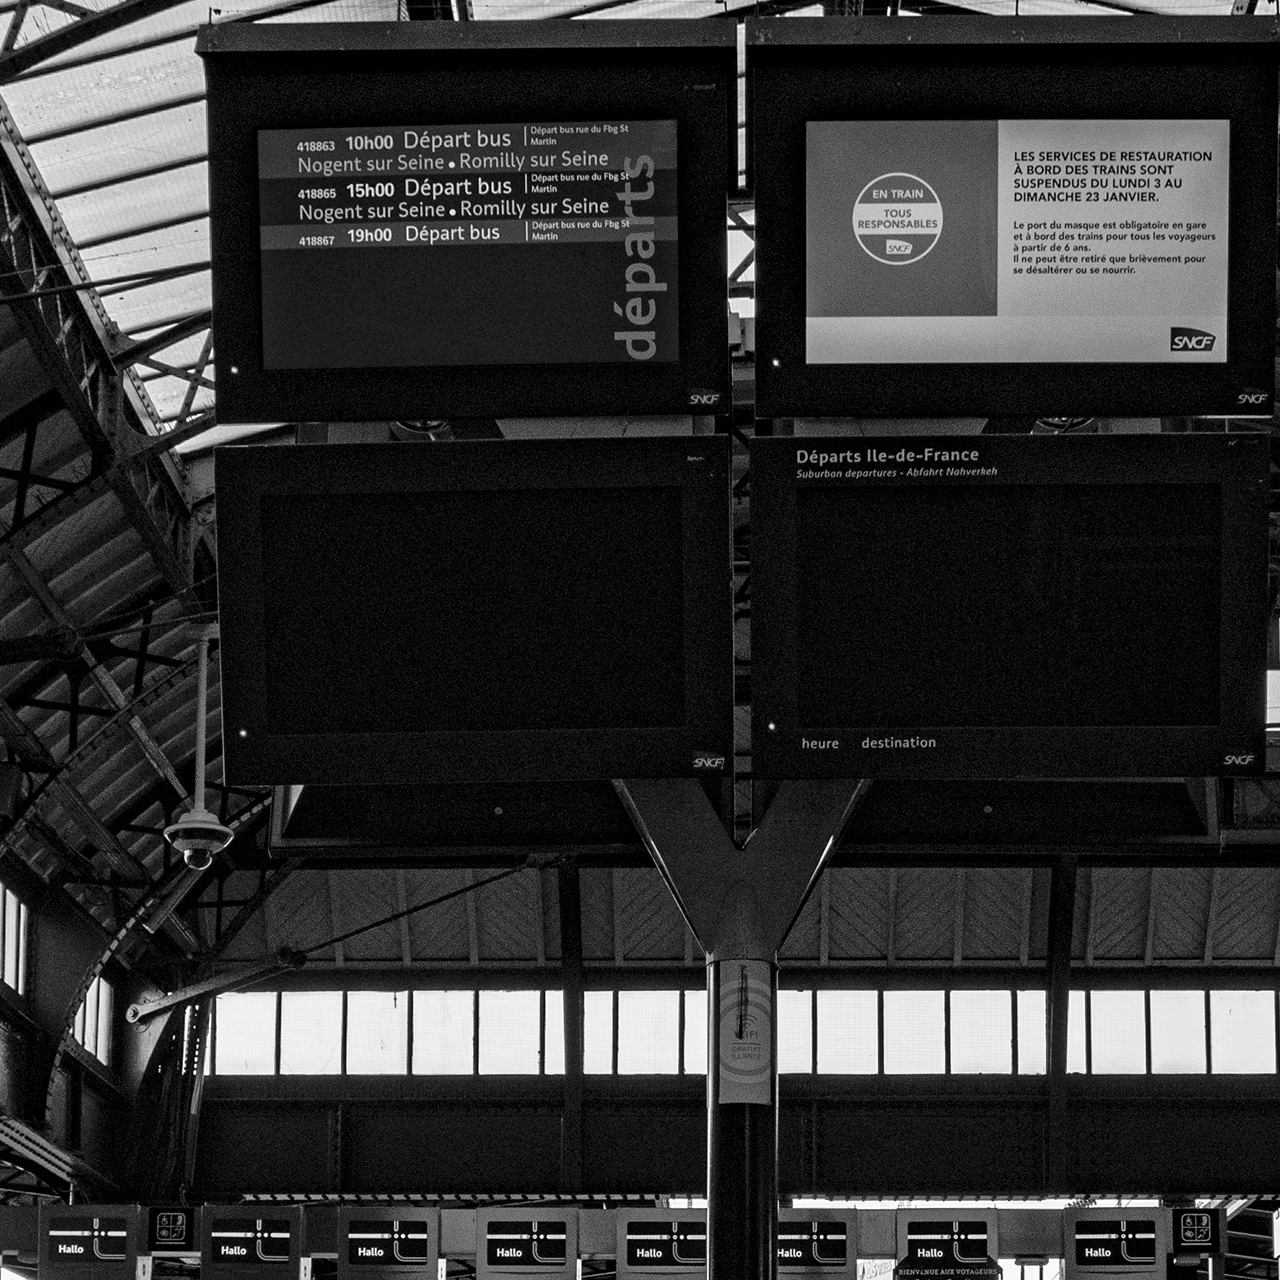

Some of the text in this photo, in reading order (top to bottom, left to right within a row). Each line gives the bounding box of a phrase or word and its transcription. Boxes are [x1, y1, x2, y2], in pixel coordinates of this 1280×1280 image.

[530, 126, 558, 136] Départ
[559, 126, 574, 134] bus
[590, 125, 601, 133] du
[603, 124, 618, 134] Fbg
[620, 124, 629, 133] St
[297, 129, 511, 153] 418863 10h00 Départ bus
[530, 137, 557, 146] Martin
[1014, 151, 1212, 162] LES SERVICES DE RESTAURATION
[298, 151, 608, 177] Nogent sur Seine Romilly sur Seine
[1014, 163, 1174, 175] À BORD DES TRAINS SONT
[531, 173, 558, 184] Départ
[560, 173, 575, 182] bus
[591, 172, 602, 181] du
[604, 172, 619, 182] Fbg
[620, 172, 630, 181] St
[1014, 178, 1182, 189] SUSPENDUS DU LUNDI 3 AU
[298, 177, 512, 200] 418865 15h00 Départ bus
[531, 184, 558, 193] Martin
[872, 189, 923, 199] EN TRAIN
[1014, 191, 1159, 202] DIMANCHE 23 JANVIER.
[300, 197, 609, 224] Nogent sur Seine Romilly sur Seine
[884, 208, 912, 218] TOUS
[532, 221, 559, 231] Départ
[561, 221, 576, 229] bus
[592, 220, 602, 228] du
[604, 219, 620, 229] Fbg
[621, 219, 630, 228] St
[858, 219, 938, 229] RESPONSABLES
[1014, 220, 1207, 232] Le port du masque est obligatoire en gare
[299, 224, 500, 246] 418867 19h00 Départ bus
[532, 232, 558, 240] Martin
[1013, 230, 1216, 243] et à bord des trains pour tous les voyageurs
[887, 244, 911, 253] SNCF
[1013, 243, 1019, 252] à
[1022, 243, 1047, 254] partir
[1050, 242, 1062, 252] de
[1064, 243, 1070, 252] 6
[614, 153, 668, 361] départs
[1013, 254, 1019, 263] Il
[1036, 255, 1056, 265] peut
[1059, 254, 1078, 263] être
[1081, 254, 1106, 263] retiré
[1109, 256, 1126, 265] que
[1129, 253, 1182, 263] brièvement
[1184, 256, 1206, 265] pour
[1026, 265, 1073, 274] désaltérer
[1075, 267, 1087, 275] ou
[1090, 267, 1100, 275] se
[1102, 265, 1136, 274] nourrir.
[1172, 336, 1213, 350] SNCF
[689, 394, 720, 405] SNCF
[1237, 393, 1269, 404] SNCF
[796, 448, 979, 467] Départs Ile-de-France
[796, 466, 998, 481] Suburban departures Abfahrt Nahverkeh
[802, 736, 936, 749] heure destination
[693, 757, 725, 769] SNCF
[1223, 755, 1255, 766] SNCF
[58, 1244, 84, 1254] Hallo
[221, 1245, 247, 1255] Hallo
[358, 1247, 384, 1257] Hallo
[496, 1247, 522, 1257] Hallo
[636, 1247, 662, 1258] Hallo
[777, 1248, 802, 1258] Hallo
[917, 1247, 944, 1258] Hallo
[1085, 1247, 1111, 1257] Hallo
[898, 1268, 998, 1276] BIENVENUE AUX VOYAGEURS
